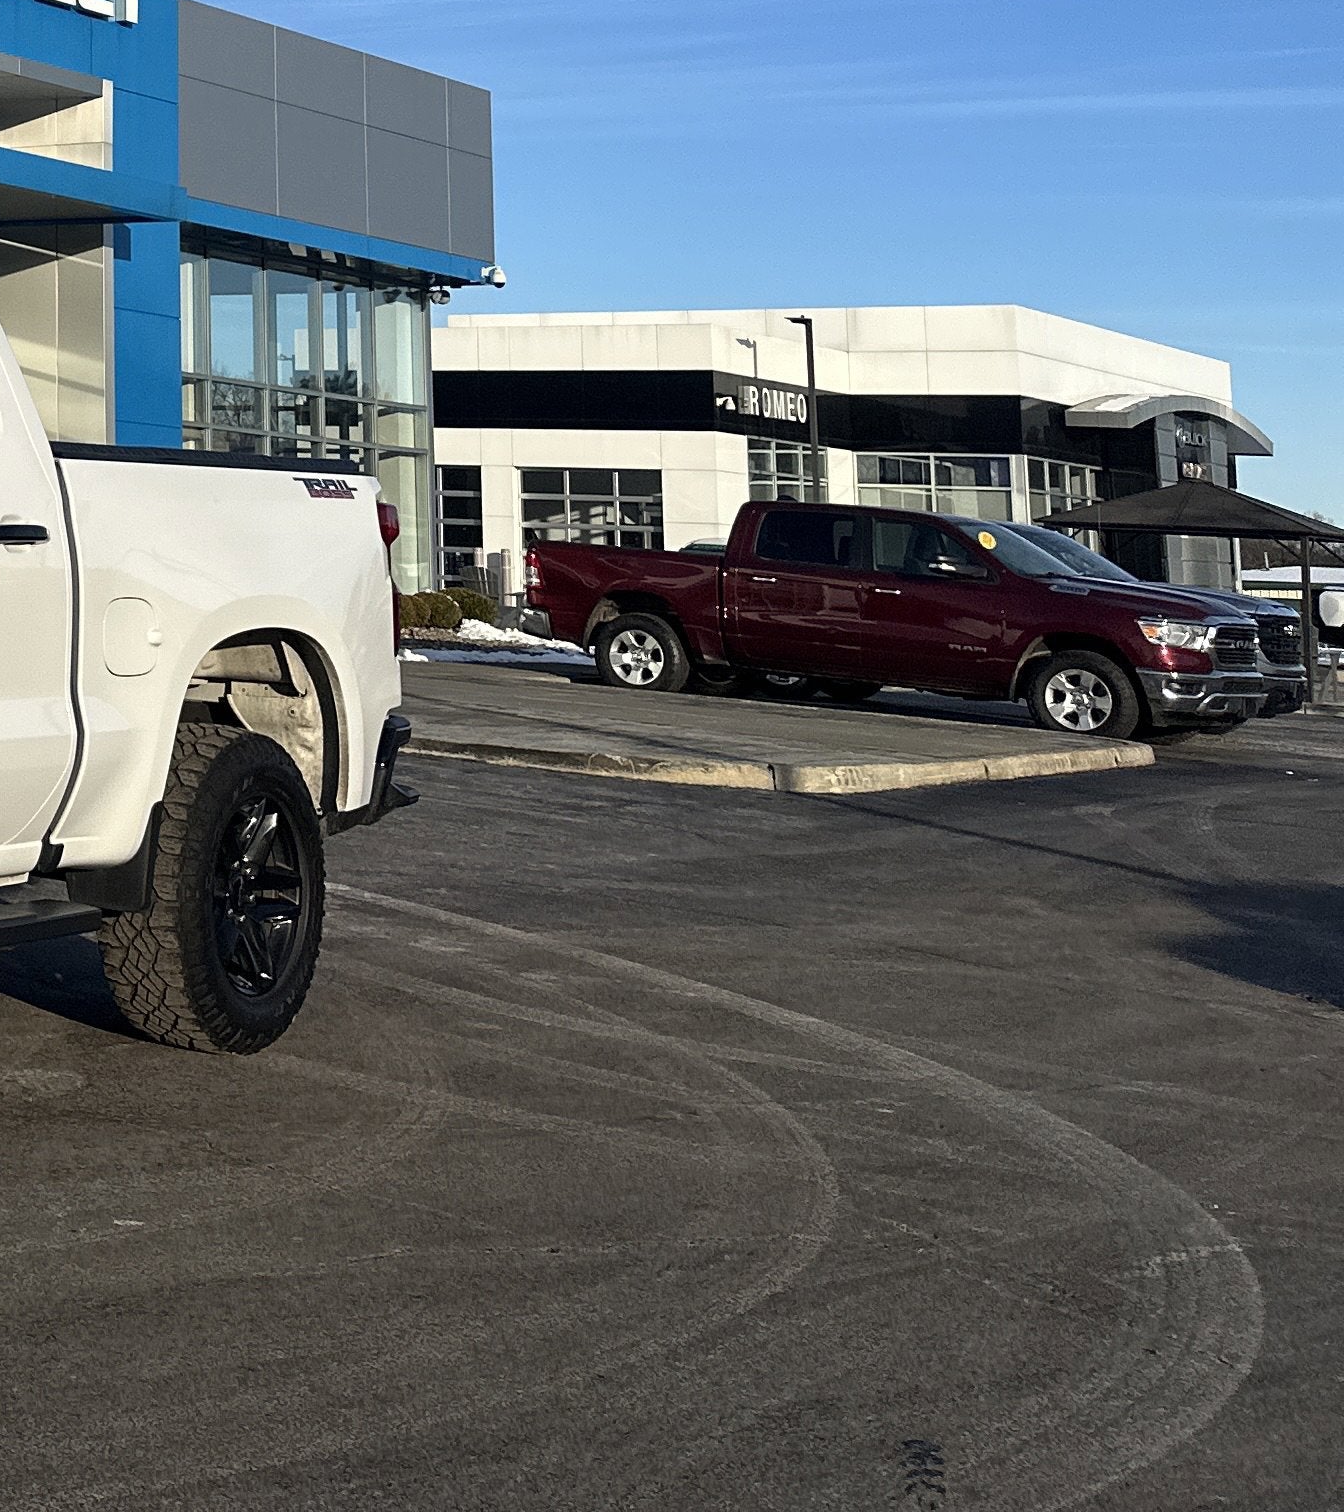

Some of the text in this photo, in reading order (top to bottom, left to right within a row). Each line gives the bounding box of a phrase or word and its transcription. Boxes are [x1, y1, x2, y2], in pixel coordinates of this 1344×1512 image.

[744, 386, 807, 423] ROMEO
[292, 477, 358, 491] TRAIL
[309, 488, 355, 499] BOSS
